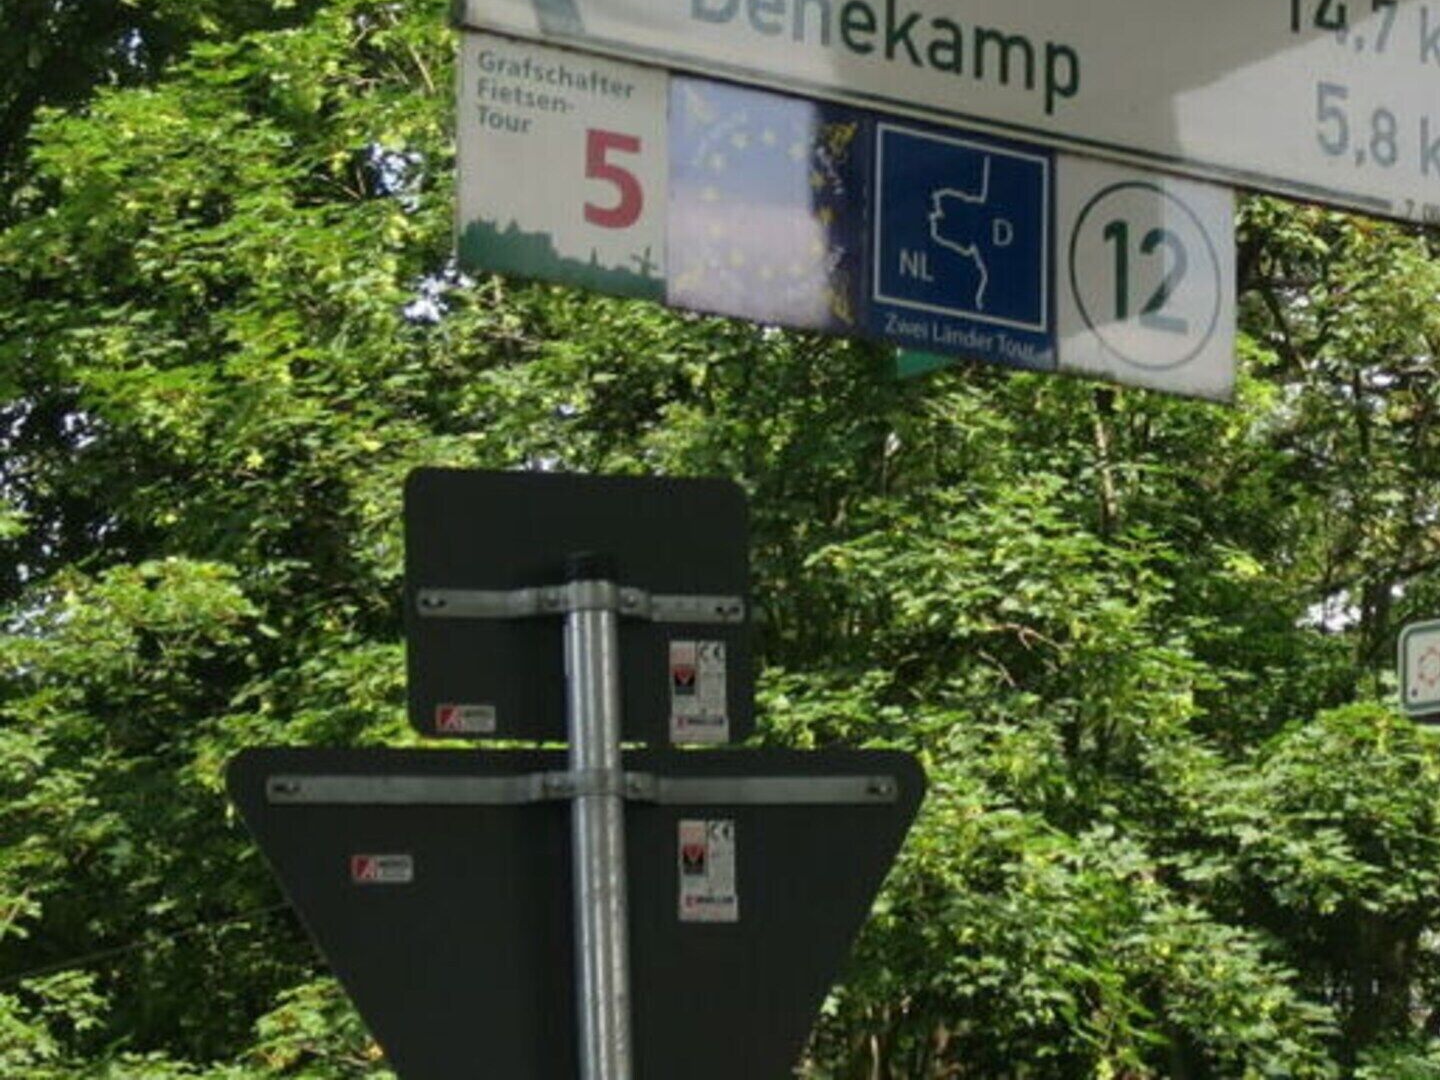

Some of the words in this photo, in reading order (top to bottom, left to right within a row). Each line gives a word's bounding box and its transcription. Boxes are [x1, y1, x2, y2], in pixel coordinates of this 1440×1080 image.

[477, 50, 635, 98] Grafschafter
[477, 77, 575, 113] Fietsen-
[476, 104, 533, 133] Tour
[1316, 81, 1398, 167] 5,8
[583, 128, 644, 229] 5
[992, 219, 1014, 247] D
[900, 252, 935, 281] NL
[1104, 220, 1188, 335] 12
[996, 334, 1036, 358] Tour
